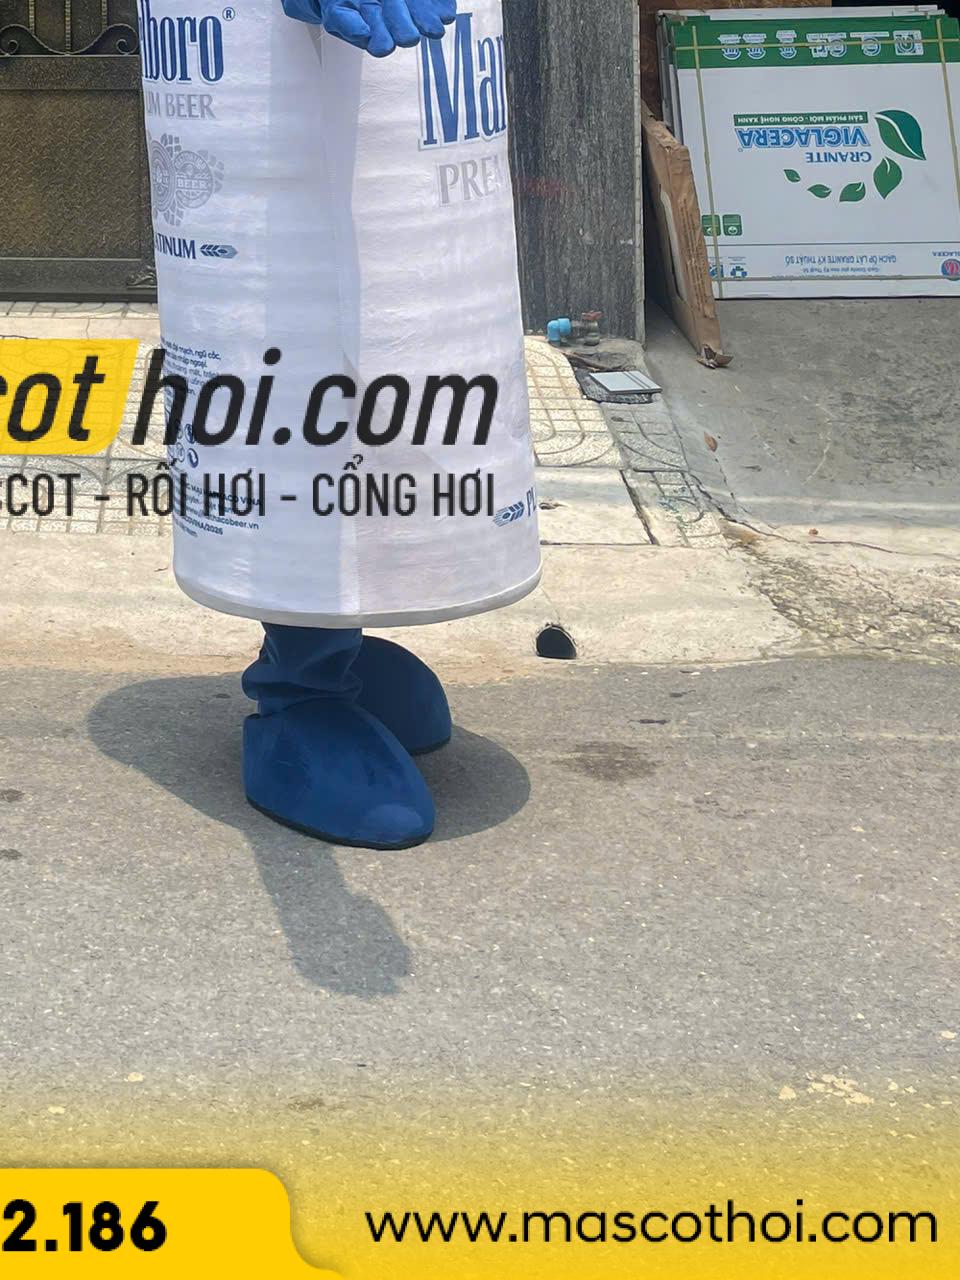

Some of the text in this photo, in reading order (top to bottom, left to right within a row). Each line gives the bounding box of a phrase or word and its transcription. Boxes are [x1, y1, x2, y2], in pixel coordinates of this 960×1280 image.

[140, 0, 225, 82] lboro
[165, 93, 217, 119] BEER
[735, 126, 871, 148] VIGLACERA
[805, 151, 872, 163] GRANITE
